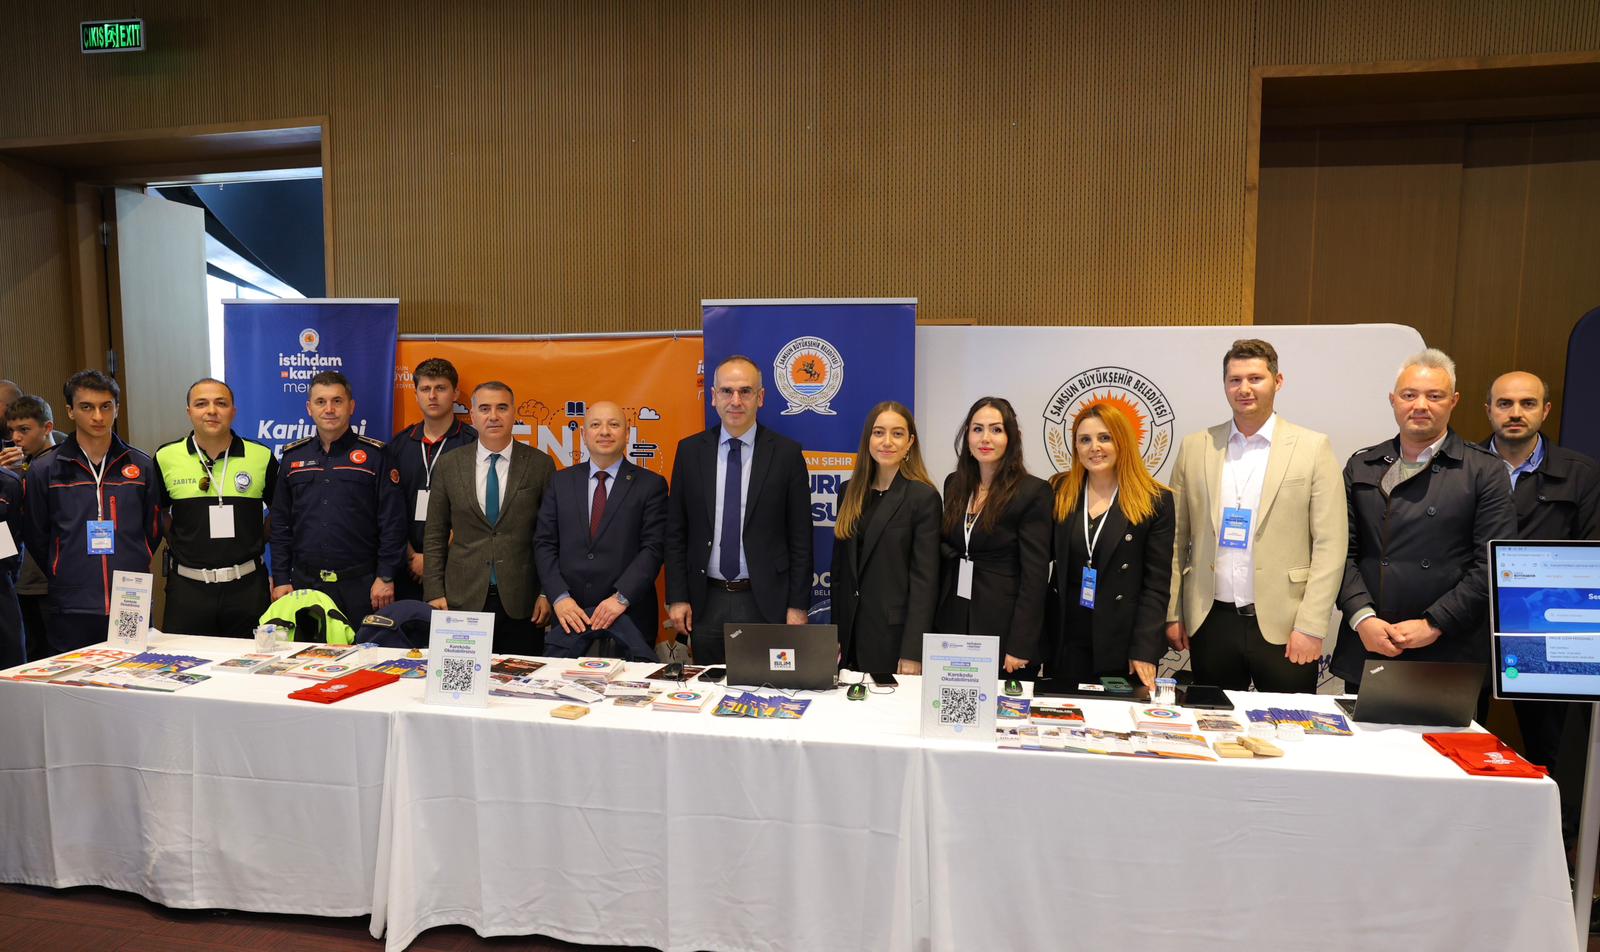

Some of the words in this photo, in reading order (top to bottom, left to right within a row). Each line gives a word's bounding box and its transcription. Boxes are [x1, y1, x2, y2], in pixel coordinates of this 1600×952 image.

[120, 24, 141, 46] EXIT
[279, 353, 342, 366] istihdam
[779, 348, 793, 365] SAMSUN
[290, 367, 339, 379] kari
[1050, 383, 1079, 417] SAMSUN
[1078, 369, 1133, 390] BÜYÜKŞEHİR
[1133, 379, 1171, 418] BELEDİYESİ
